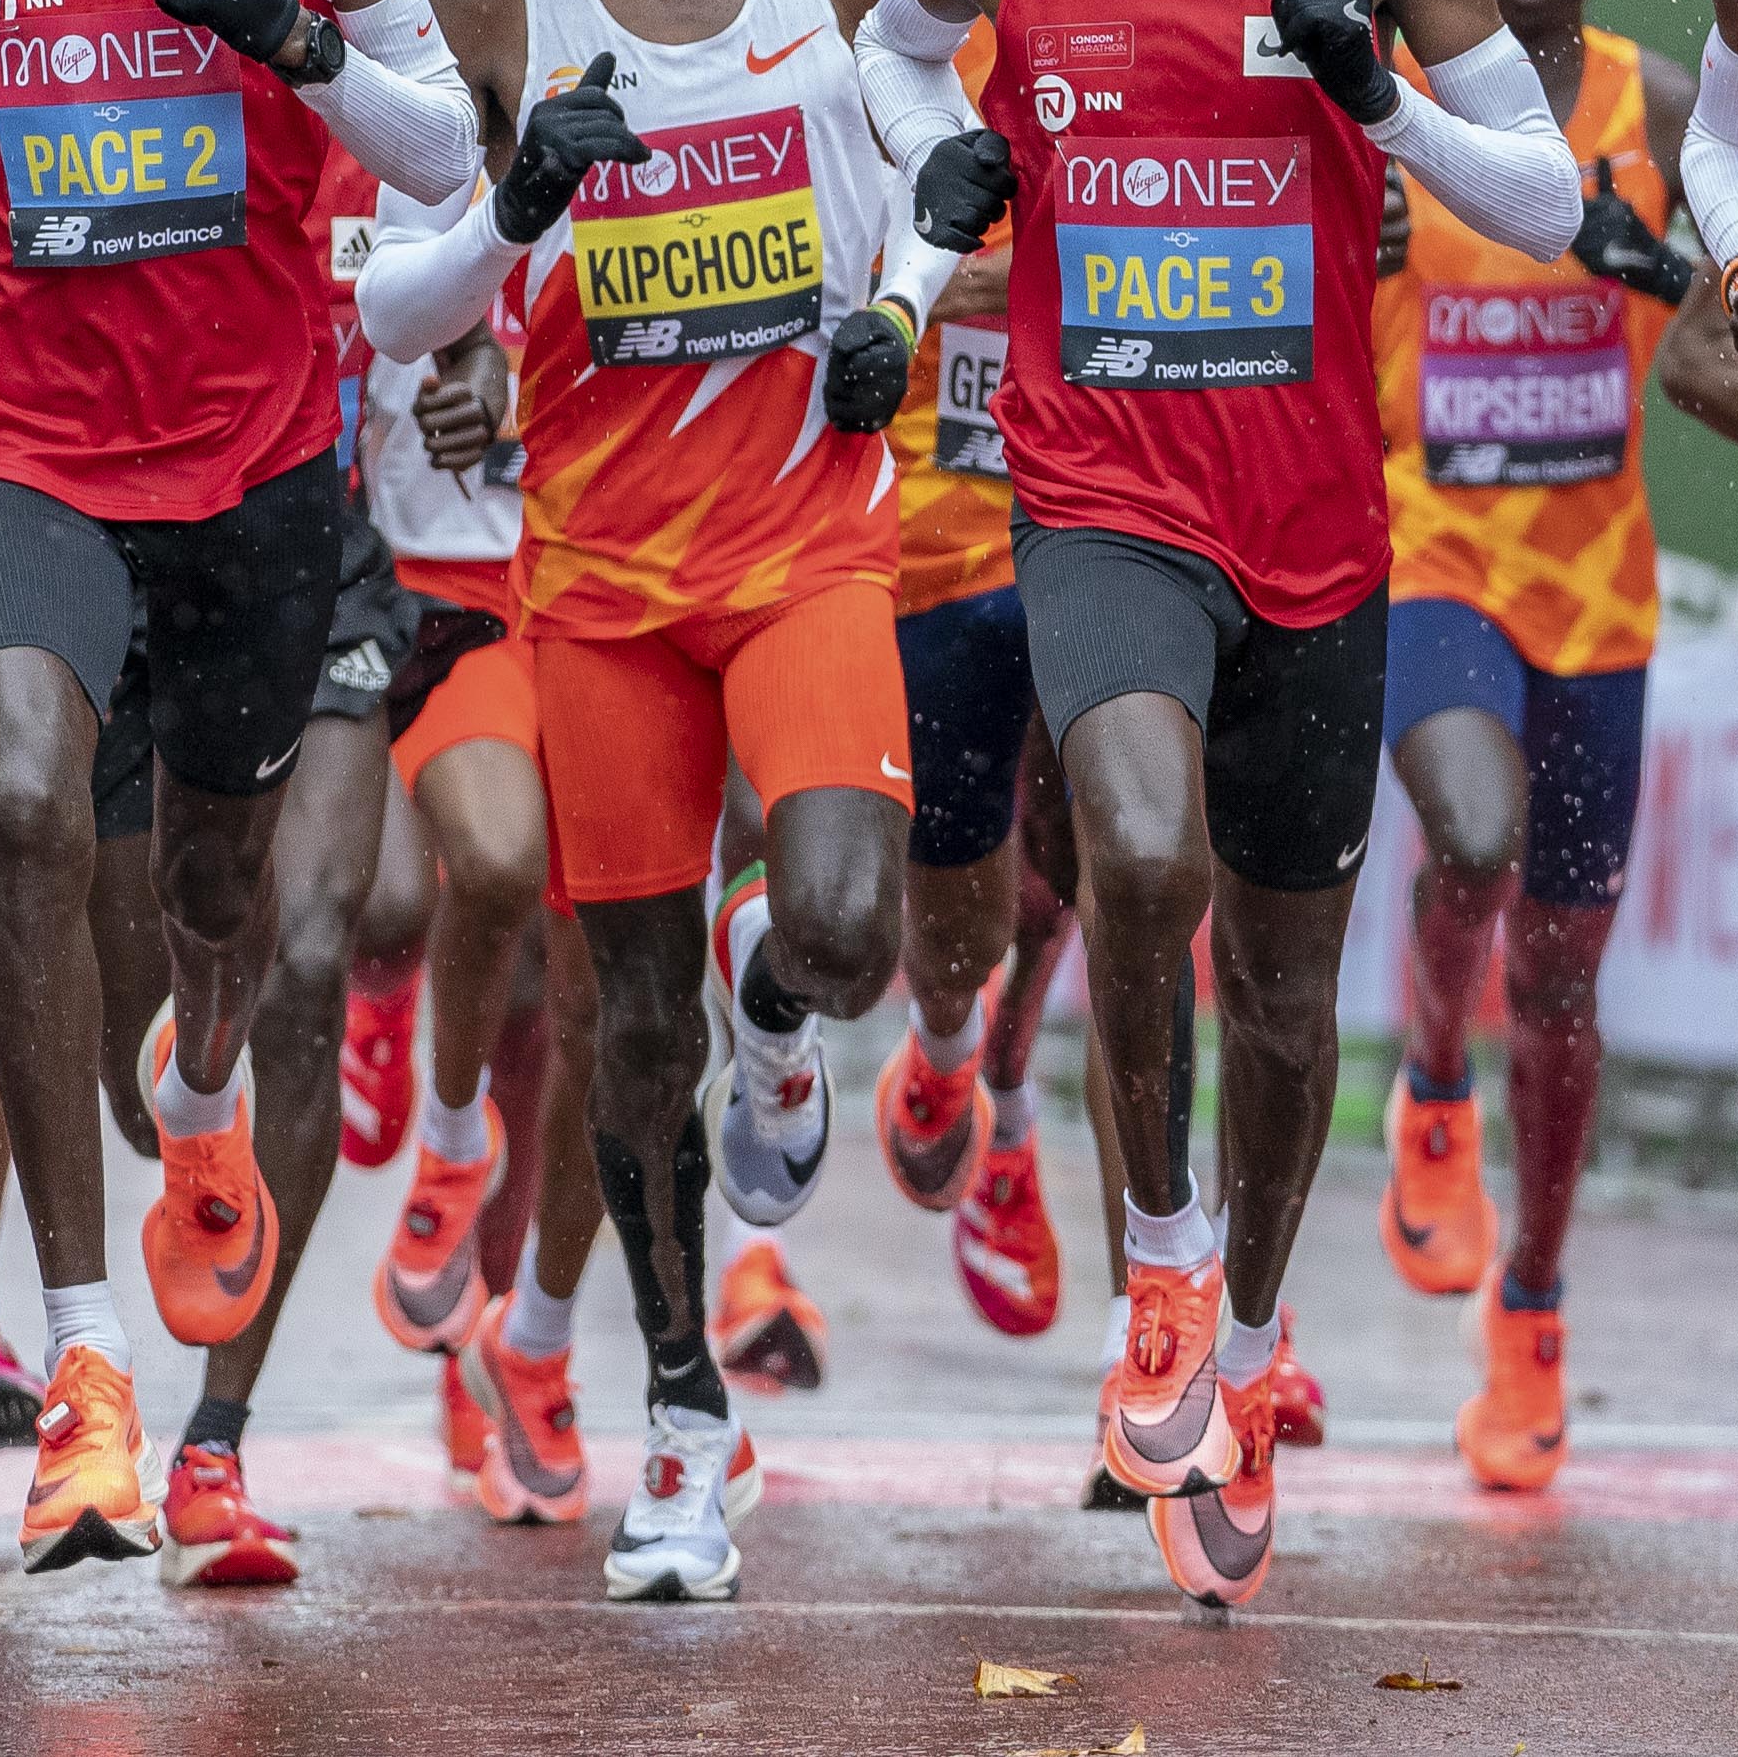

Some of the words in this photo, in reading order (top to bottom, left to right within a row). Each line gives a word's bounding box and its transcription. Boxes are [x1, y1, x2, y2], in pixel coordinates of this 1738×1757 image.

[0, 28, 219, 87] MONEY
[54, 42, 92, 75] Virgin
[1070, 34, 1113, 45] LONDON
[1070, 43, 1127, 54] MARATHON
[1083, 91, 1123, 111] NN
[23, 128, 166, 196] PACE
[183, 125, 219, 187] 2
[1066, 156, 1296, 206] MONEY
[1127, 165, 1164, 198] Virgin
[93, 235, 134, 255] new
[138, 224, 223, 249] balance
[587, 218, 814, 307] KIPCHOGE
[1084, 254, 1231, 320] PACE
[1250, 255, 1285, 316] 3
[686, 333, 728, 355] new
[730, 316, 807, 348] balance
[1428, 291, 1621, 344] MONEY
[1155, 363, 1198, 379] new
[1202, 357, 1289, 379] balance
[1426, 367, 1627, 436] KIPSEREM
